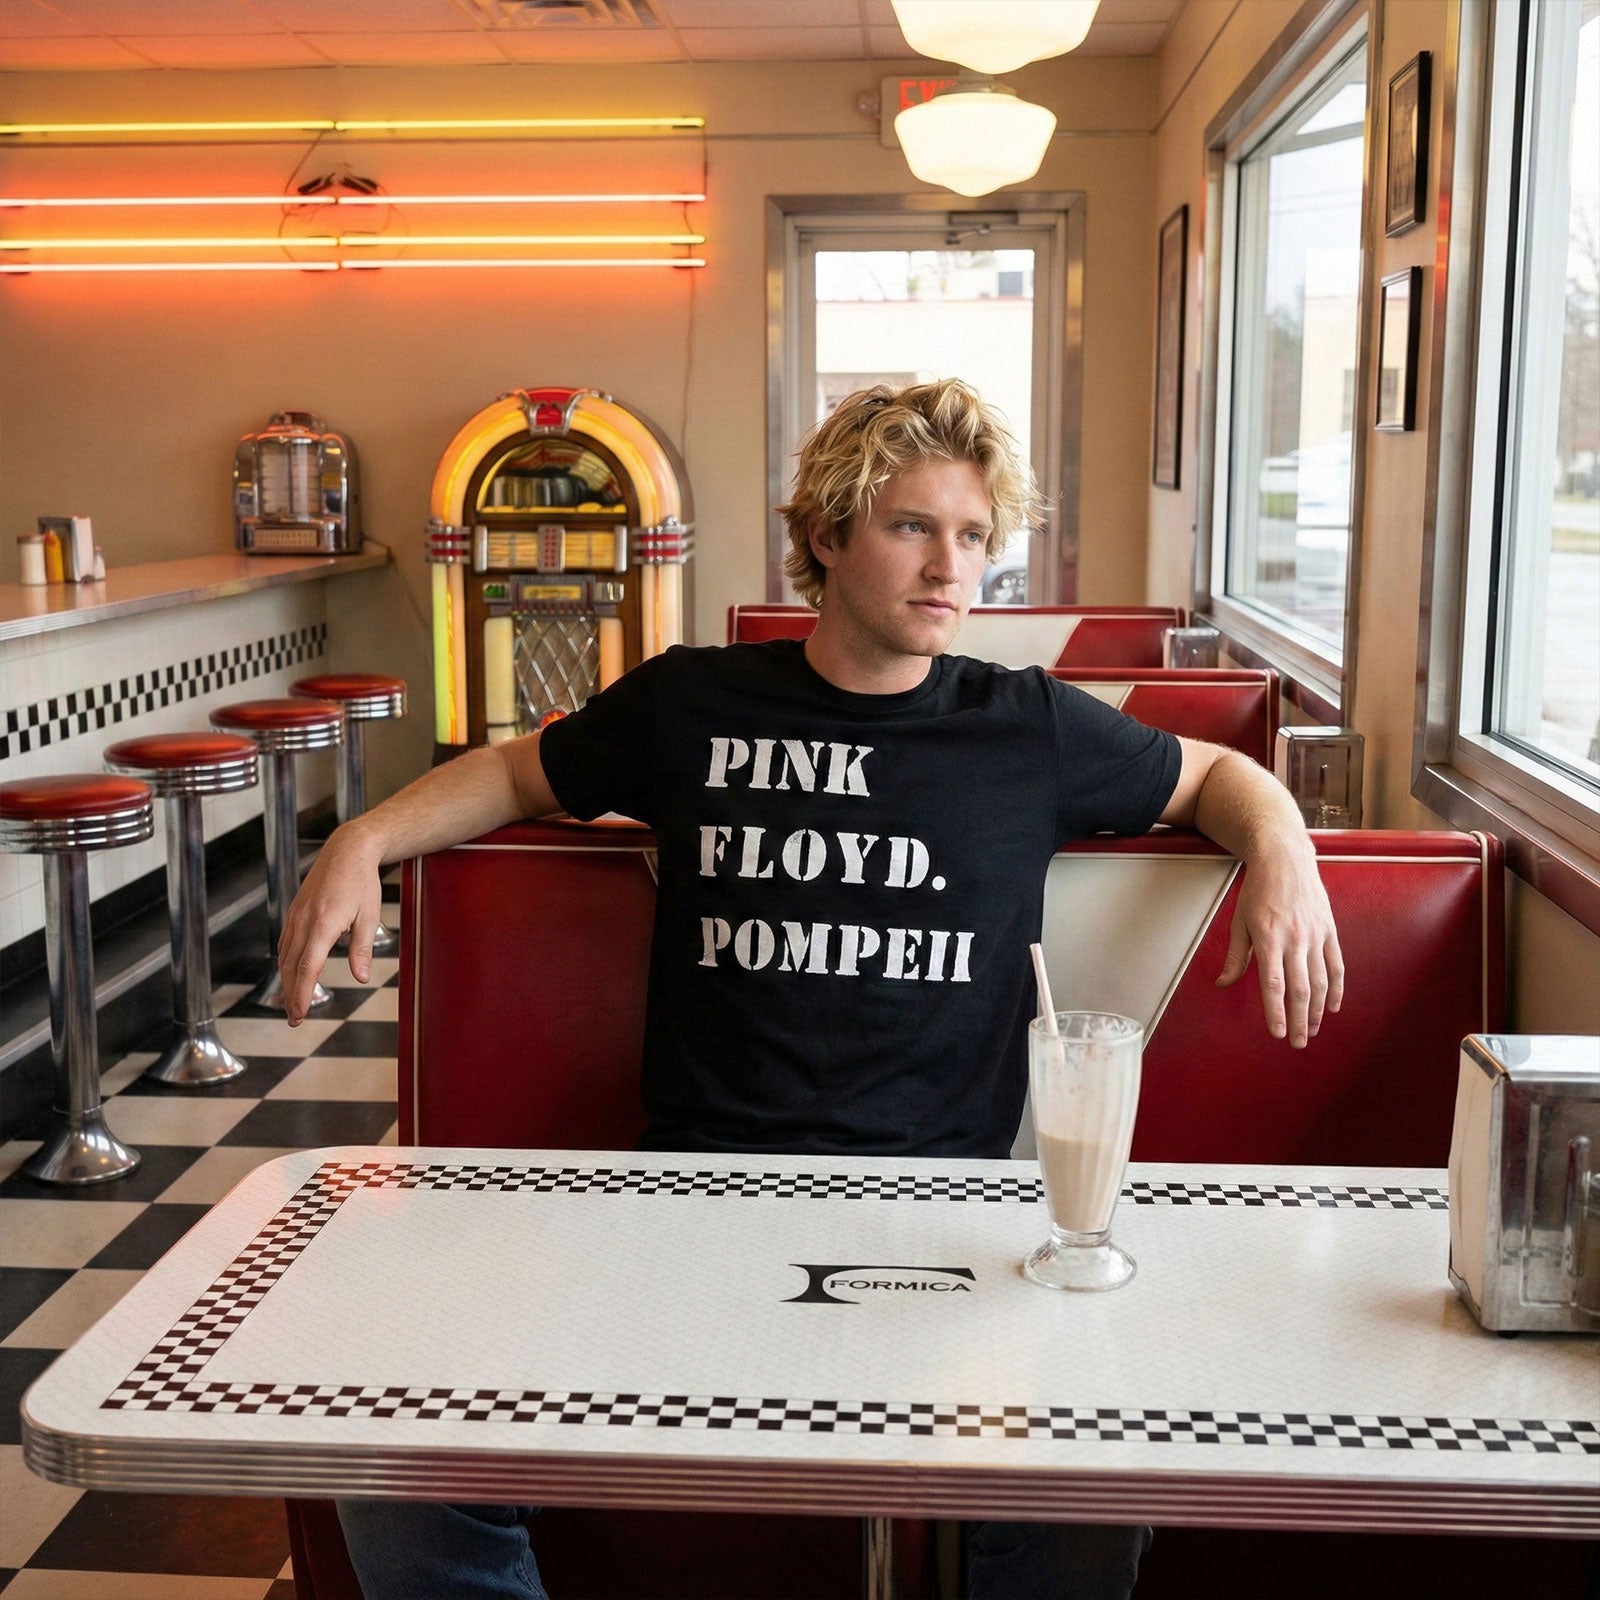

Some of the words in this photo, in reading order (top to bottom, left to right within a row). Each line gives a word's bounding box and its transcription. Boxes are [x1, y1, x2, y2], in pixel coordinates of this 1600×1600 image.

[704, 737, 874, 797] PINK
[699, 825, 947, 891] FLOYD.
[698, 917, 975, 982] POMPEII
[829, 1279, 973, 1292] FORMICA
